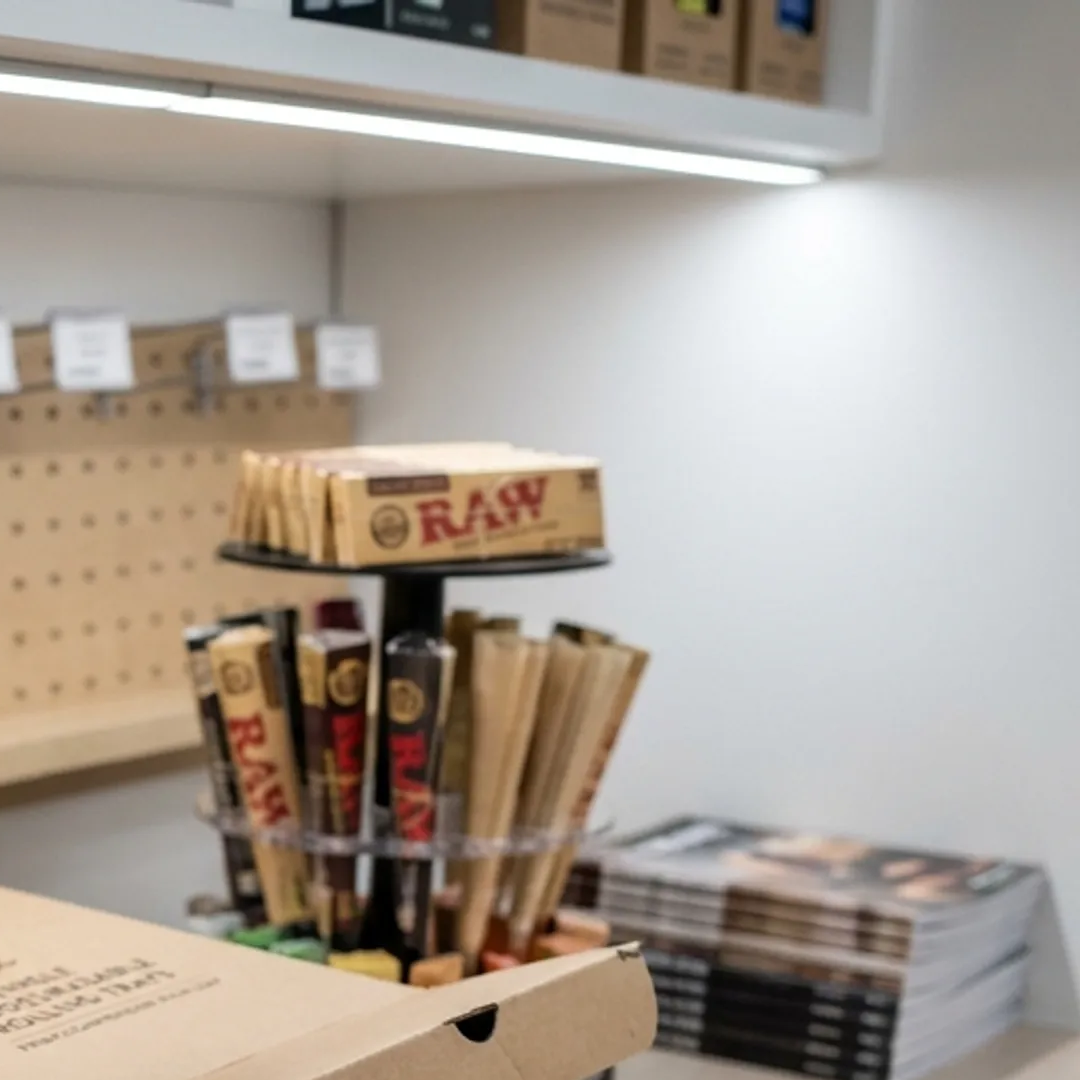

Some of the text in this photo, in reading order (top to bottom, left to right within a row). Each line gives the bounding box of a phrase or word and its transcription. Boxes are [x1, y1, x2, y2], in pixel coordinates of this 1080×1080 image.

[417, 475, 549, 547] RAW
[228, 712, 290, 827] RAW
[388, 731, 436, 844] RAW
